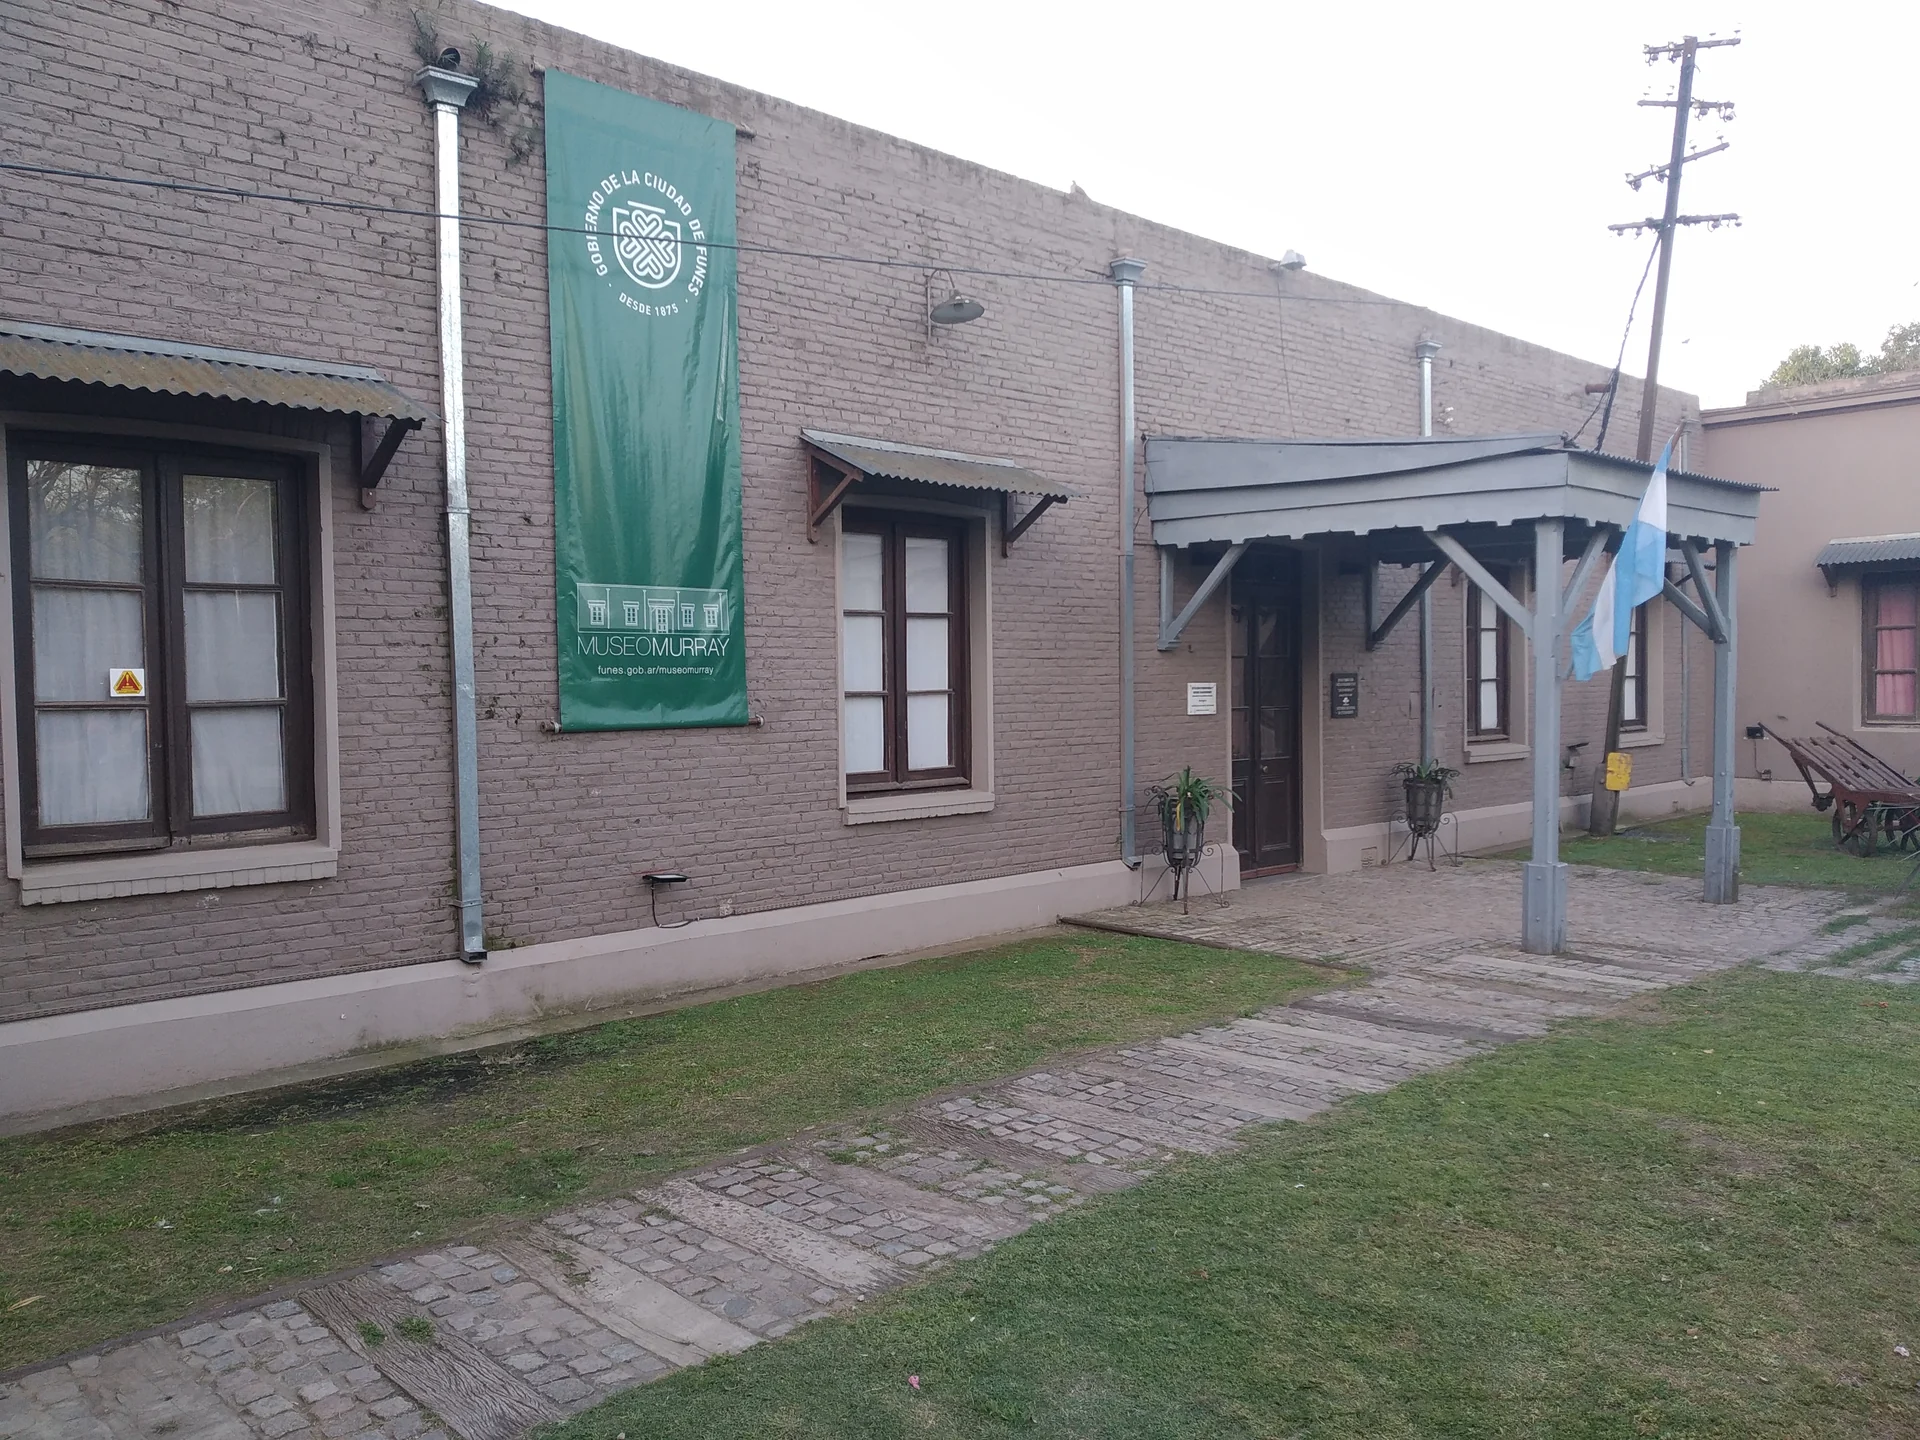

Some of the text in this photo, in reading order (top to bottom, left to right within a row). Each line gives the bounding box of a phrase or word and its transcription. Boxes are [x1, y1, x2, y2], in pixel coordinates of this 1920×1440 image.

[585, 169, 708, 297] GOBIERNO DE LA CIUDAD DE FUNES
[618, 292, 679, 317] DESDE 1875
[597, 665, 714, 676] funes.gob.ar/museomurray
